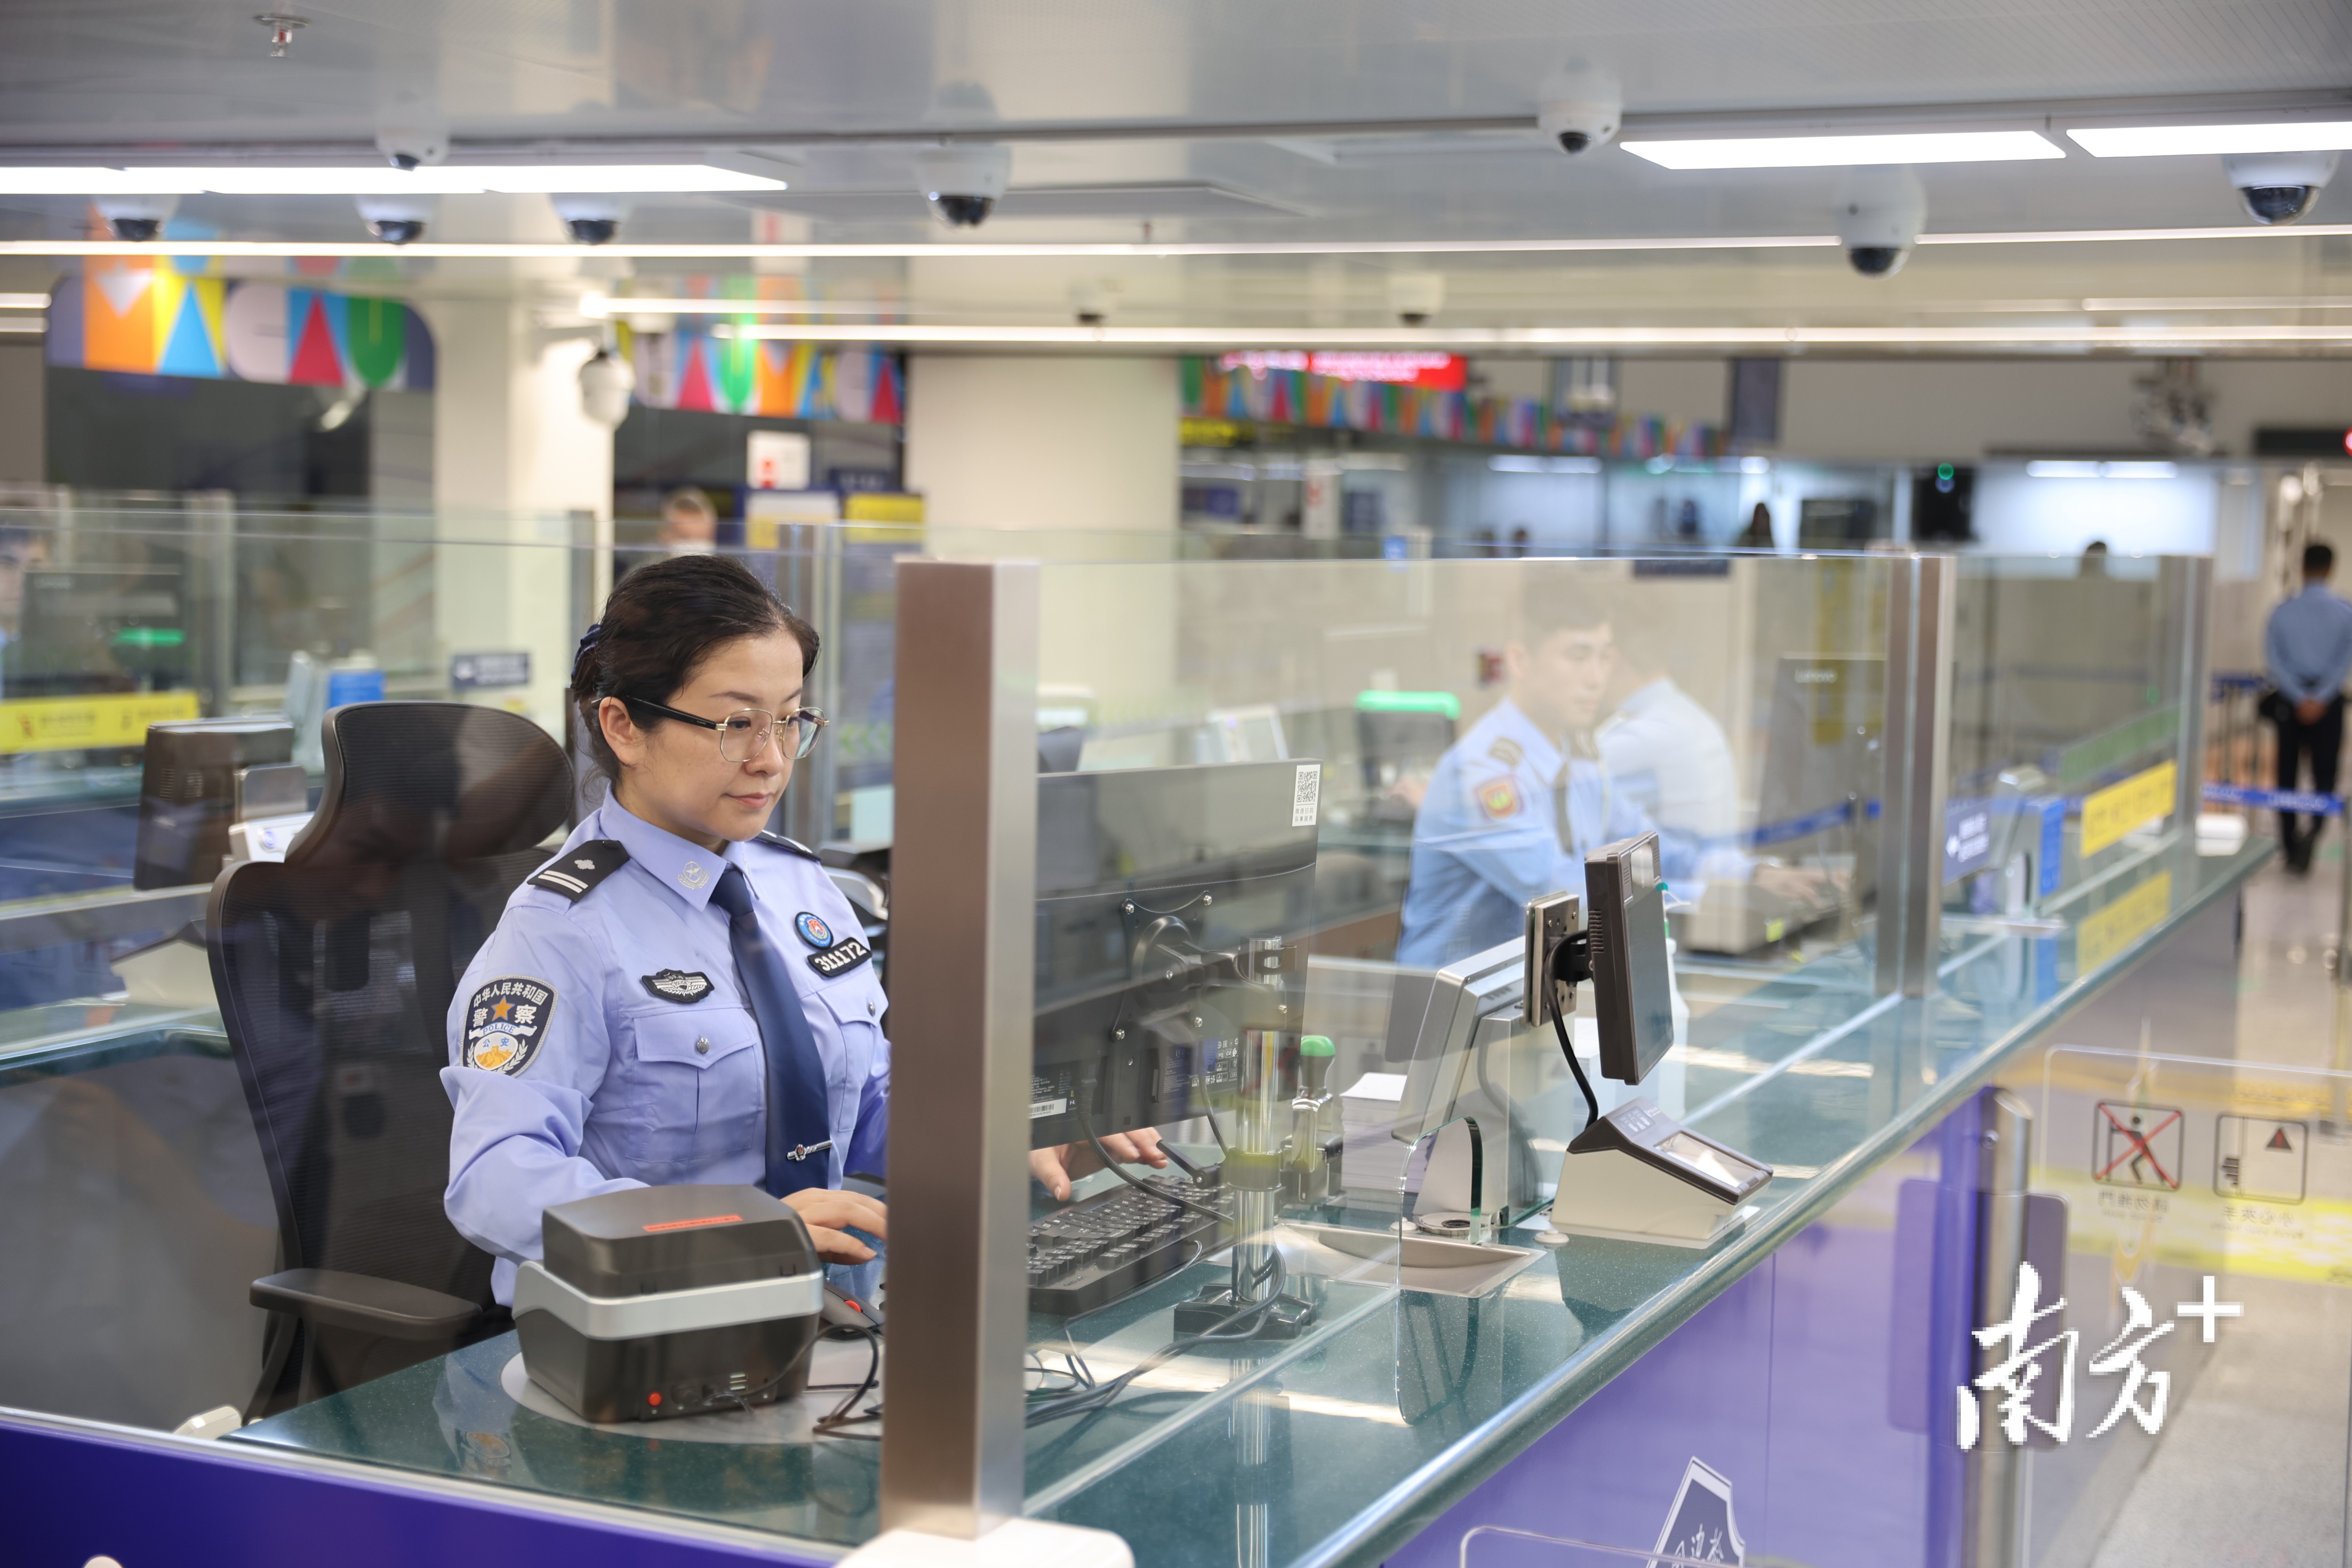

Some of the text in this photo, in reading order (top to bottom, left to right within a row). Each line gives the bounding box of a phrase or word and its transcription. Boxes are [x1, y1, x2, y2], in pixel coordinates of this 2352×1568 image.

[814, 942, 867, 971] 311172
[474, 982, 548, 1008] 中华人民共和国
[473, 1005, 537, 1027] 警察
[483, 1022, 516, 1035] POLICE
[483, 1037, 509, 1047] 公安
